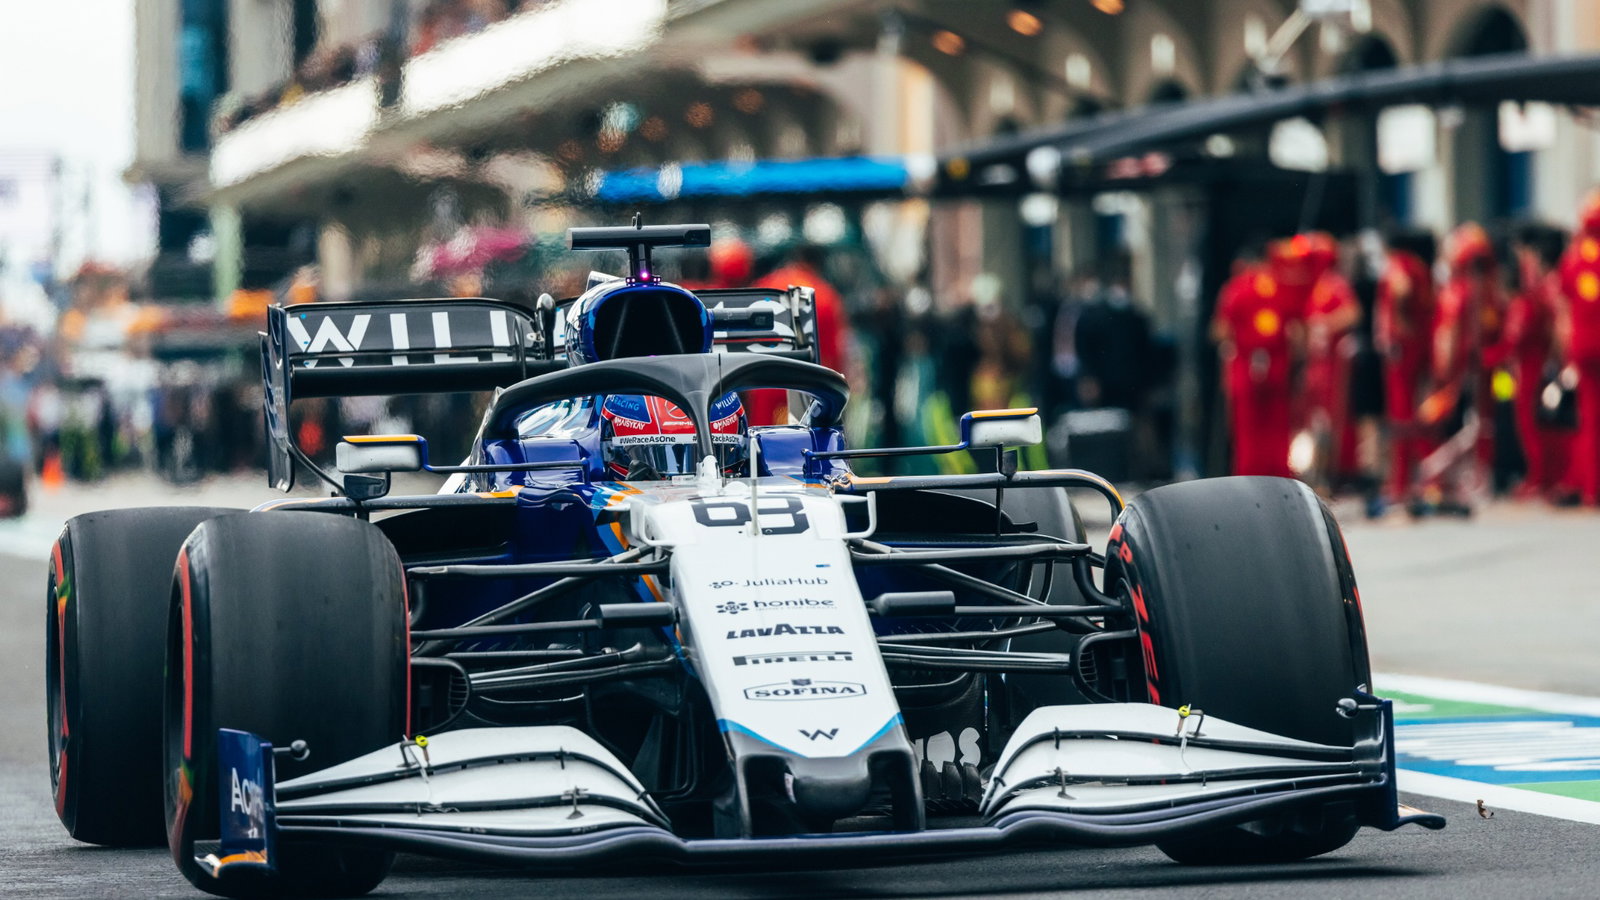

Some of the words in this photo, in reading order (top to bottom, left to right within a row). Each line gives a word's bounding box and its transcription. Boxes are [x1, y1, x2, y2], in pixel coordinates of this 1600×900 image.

[614, 396, 641, 411] RACING
[619, 435, 676, 445] #WeRaceAsOne
[690, 495, 810, 536] 63
[744, 577, 829, 587] JuliaHub
[753, 599, 835, 608] honibe
[726, 623, 845, 639] LAVAZZA
[732, 651, 853, 667] PIRELLI
[755, 686, 858, 698] SOFINA
